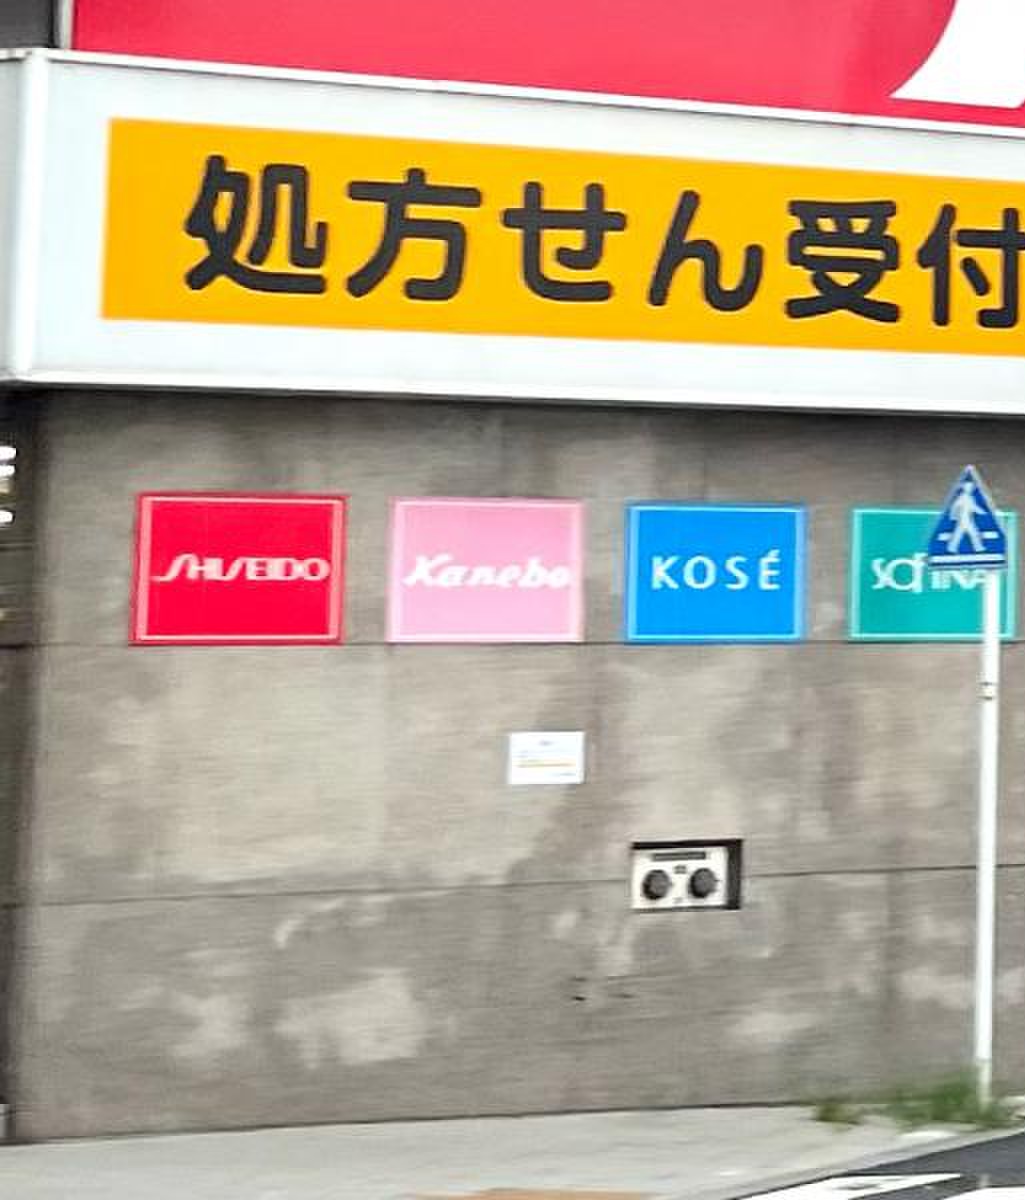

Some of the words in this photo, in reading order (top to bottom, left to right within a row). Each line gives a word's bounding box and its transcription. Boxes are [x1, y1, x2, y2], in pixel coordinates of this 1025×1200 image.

[151, 552, 331, 583] SHISEIDO
[404, 553, 574, 589] Kanebo
[650, 548, 782, 591] KOSÉ
